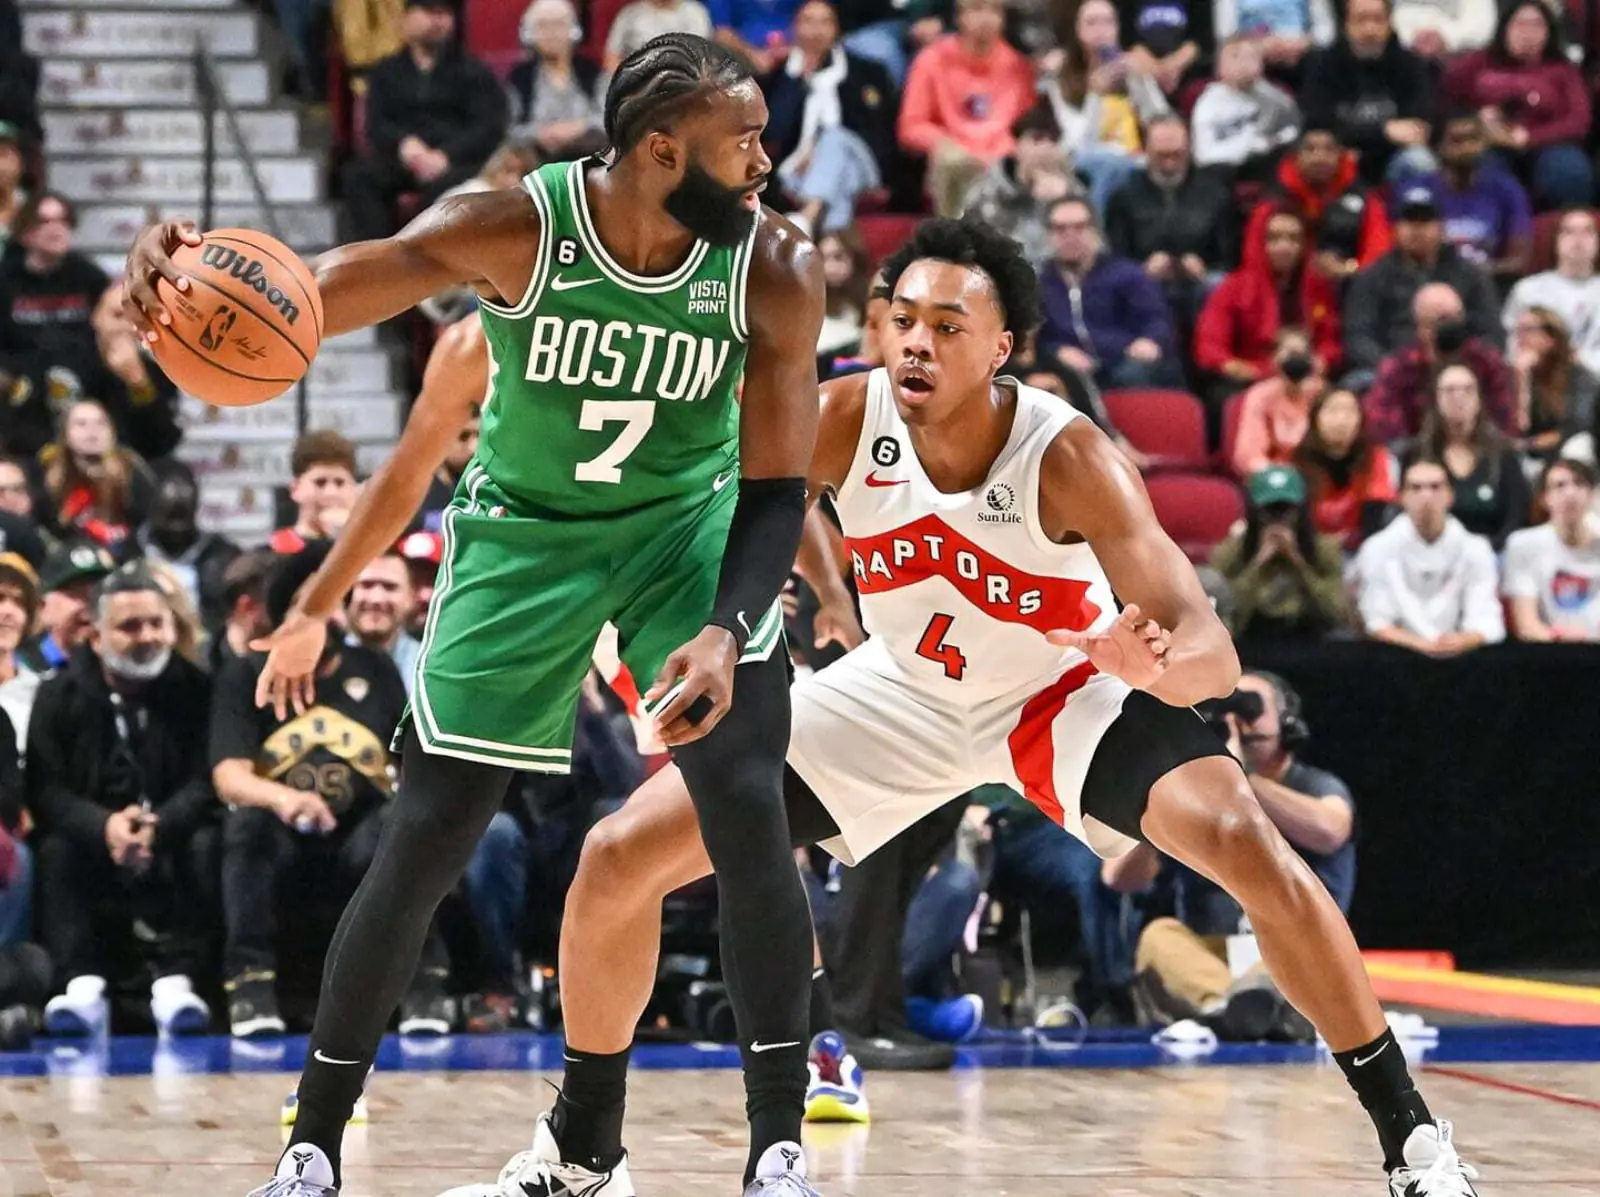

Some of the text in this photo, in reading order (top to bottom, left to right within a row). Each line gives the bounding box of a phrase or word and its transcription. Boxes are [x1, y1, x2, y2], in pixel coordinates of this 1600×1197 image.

[558, 240, 577, 264] 6
[202, 244, 300, 326] Wilson
[688, 301, 727, 314] PRINT
[689, 280, 727, 299] VISTA
[525, 316, 730, 401] BOSTON
[575, 399, 657, 484] 7
[877, 440, 894, 463] 6
[977, 512, 1022, 523] Sun Life
[852, 534, 1042, 615] RAPTORS
[915, 612, 967, 682] 4
